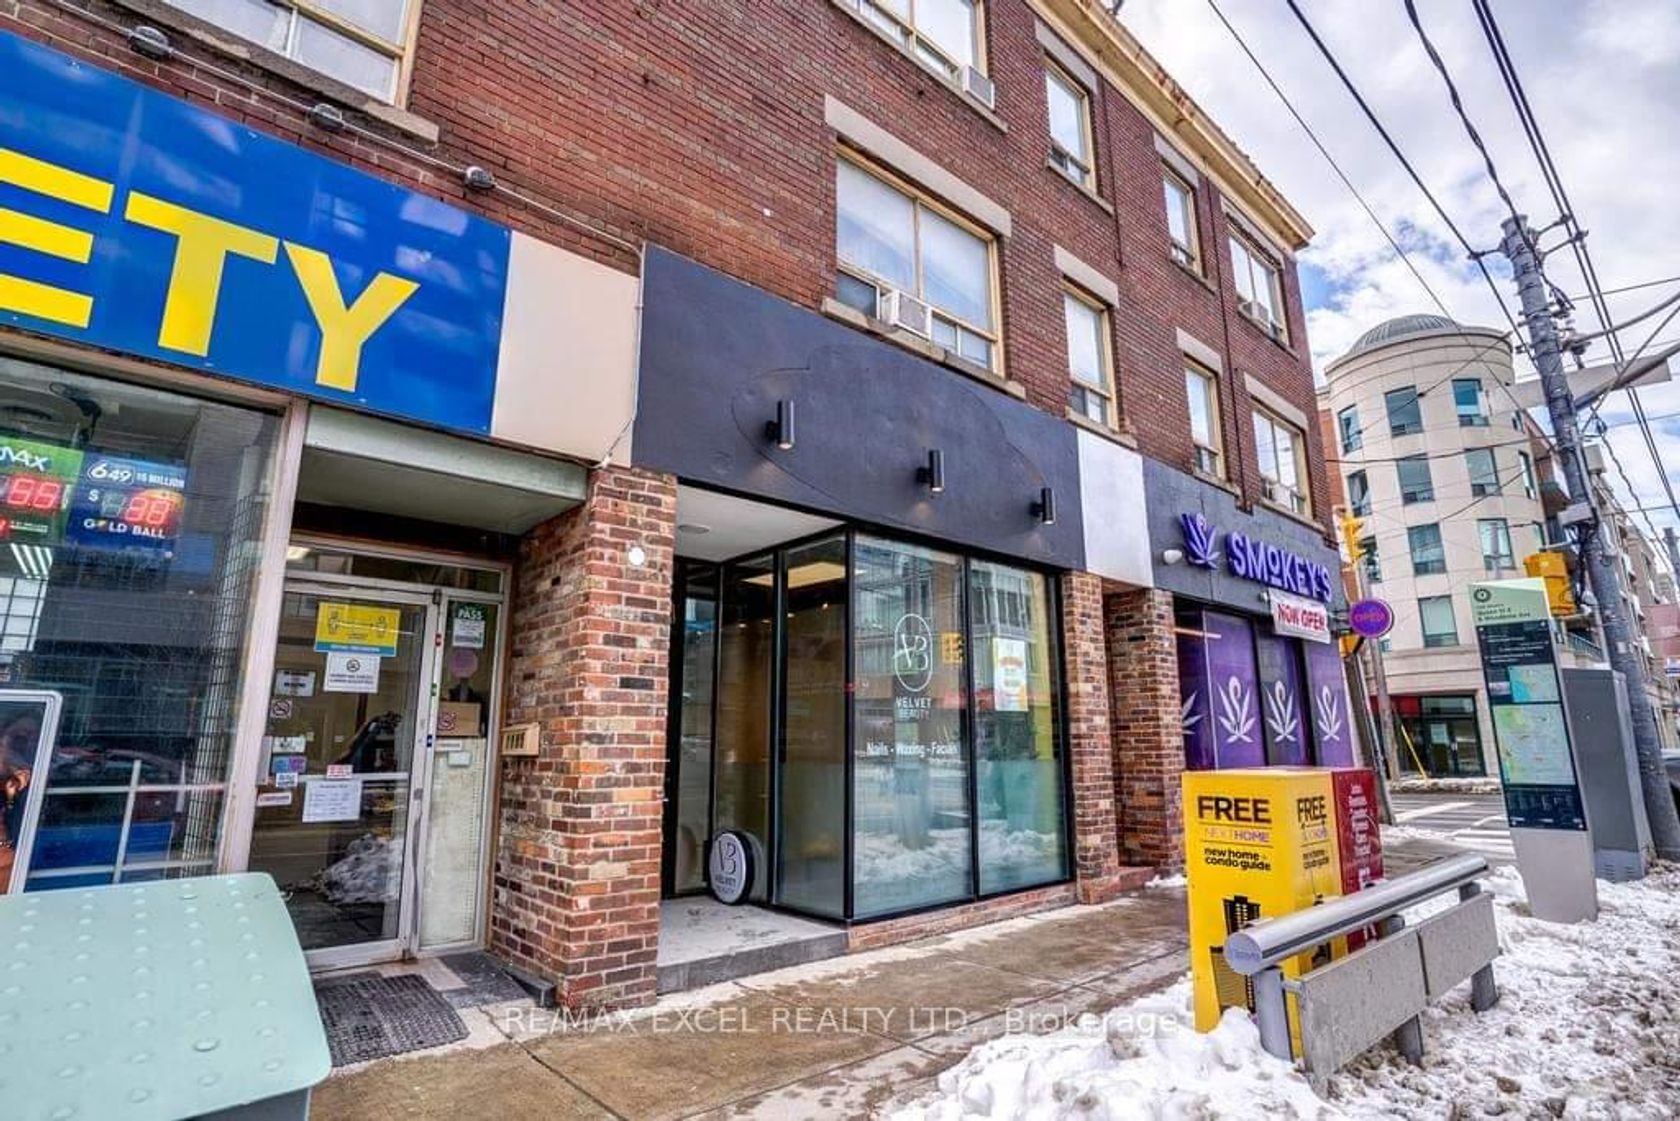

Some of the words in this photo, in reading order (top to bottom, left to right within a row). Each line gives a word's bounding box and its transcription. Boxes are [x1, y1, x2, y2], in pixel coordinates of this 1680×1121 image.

[0, 147, 421, 393] ETY
[131, 525, 166, 540] BALL
[1228, 531, 1333, 604] SMOKEY'S
[1301, 609, 1326, 632] OPEN
[896, 696, 932, 709] VELVET
[1197, 795, 1273, 824] FREE
[1297, 796, 1327, 823] FREE
[1204, 847, 1227, 858] new
[1228, 847, 1261, 861] home
[1205, 856, 1240, 868] condo
[1240, 859, 1272, 872] guide
